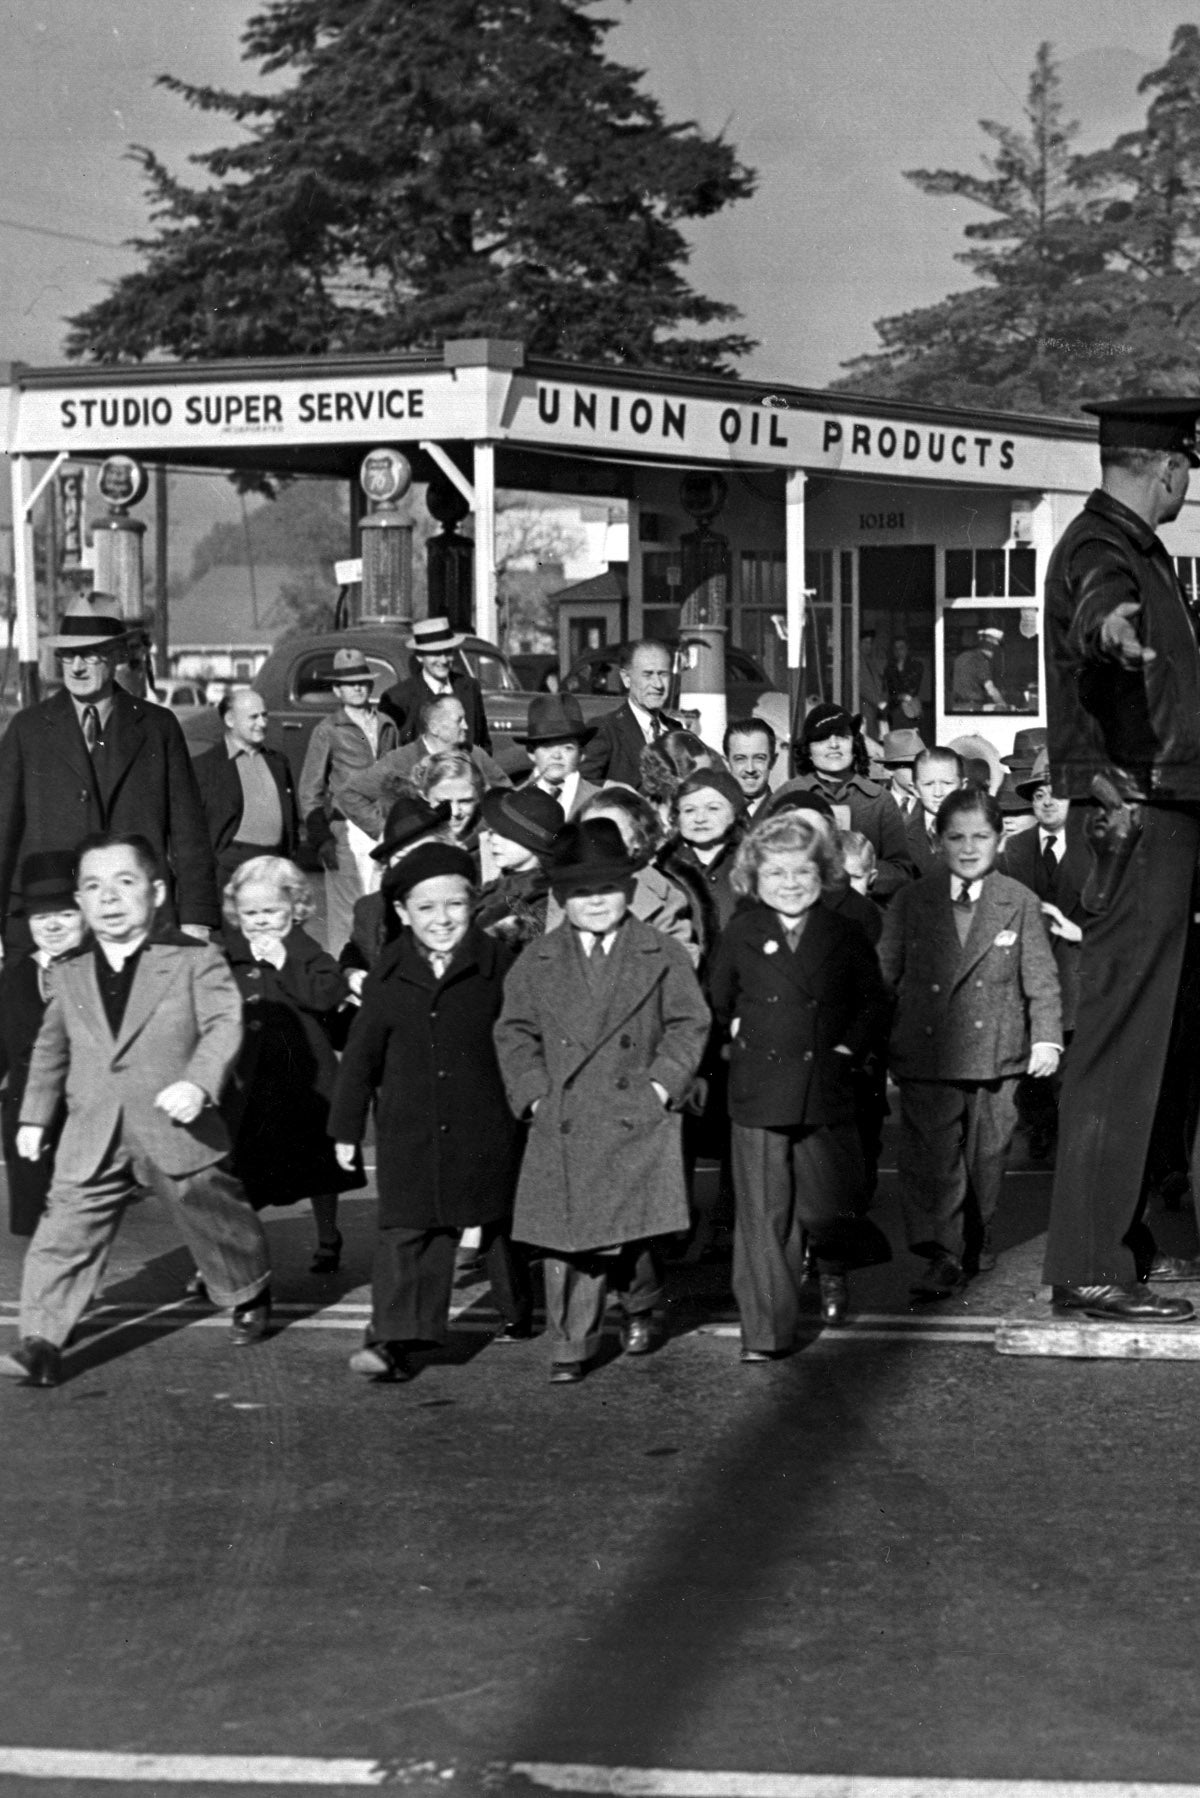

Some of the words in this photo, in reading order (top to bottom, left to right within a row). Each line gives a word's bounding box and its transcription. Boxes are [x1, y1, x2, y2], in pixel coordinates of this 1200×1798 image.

[61, 397, 173, 428] STUDIO
[186, 395, 283, 424] SUPER
[299, 389, 424, 422] SERVICE
[538, 387, 686, 440] UNION
[720, 407, 788, 447] OIL
[823, 420, 1015, 470] PRODUCTS
[859, 512, 905, 529] 10181
